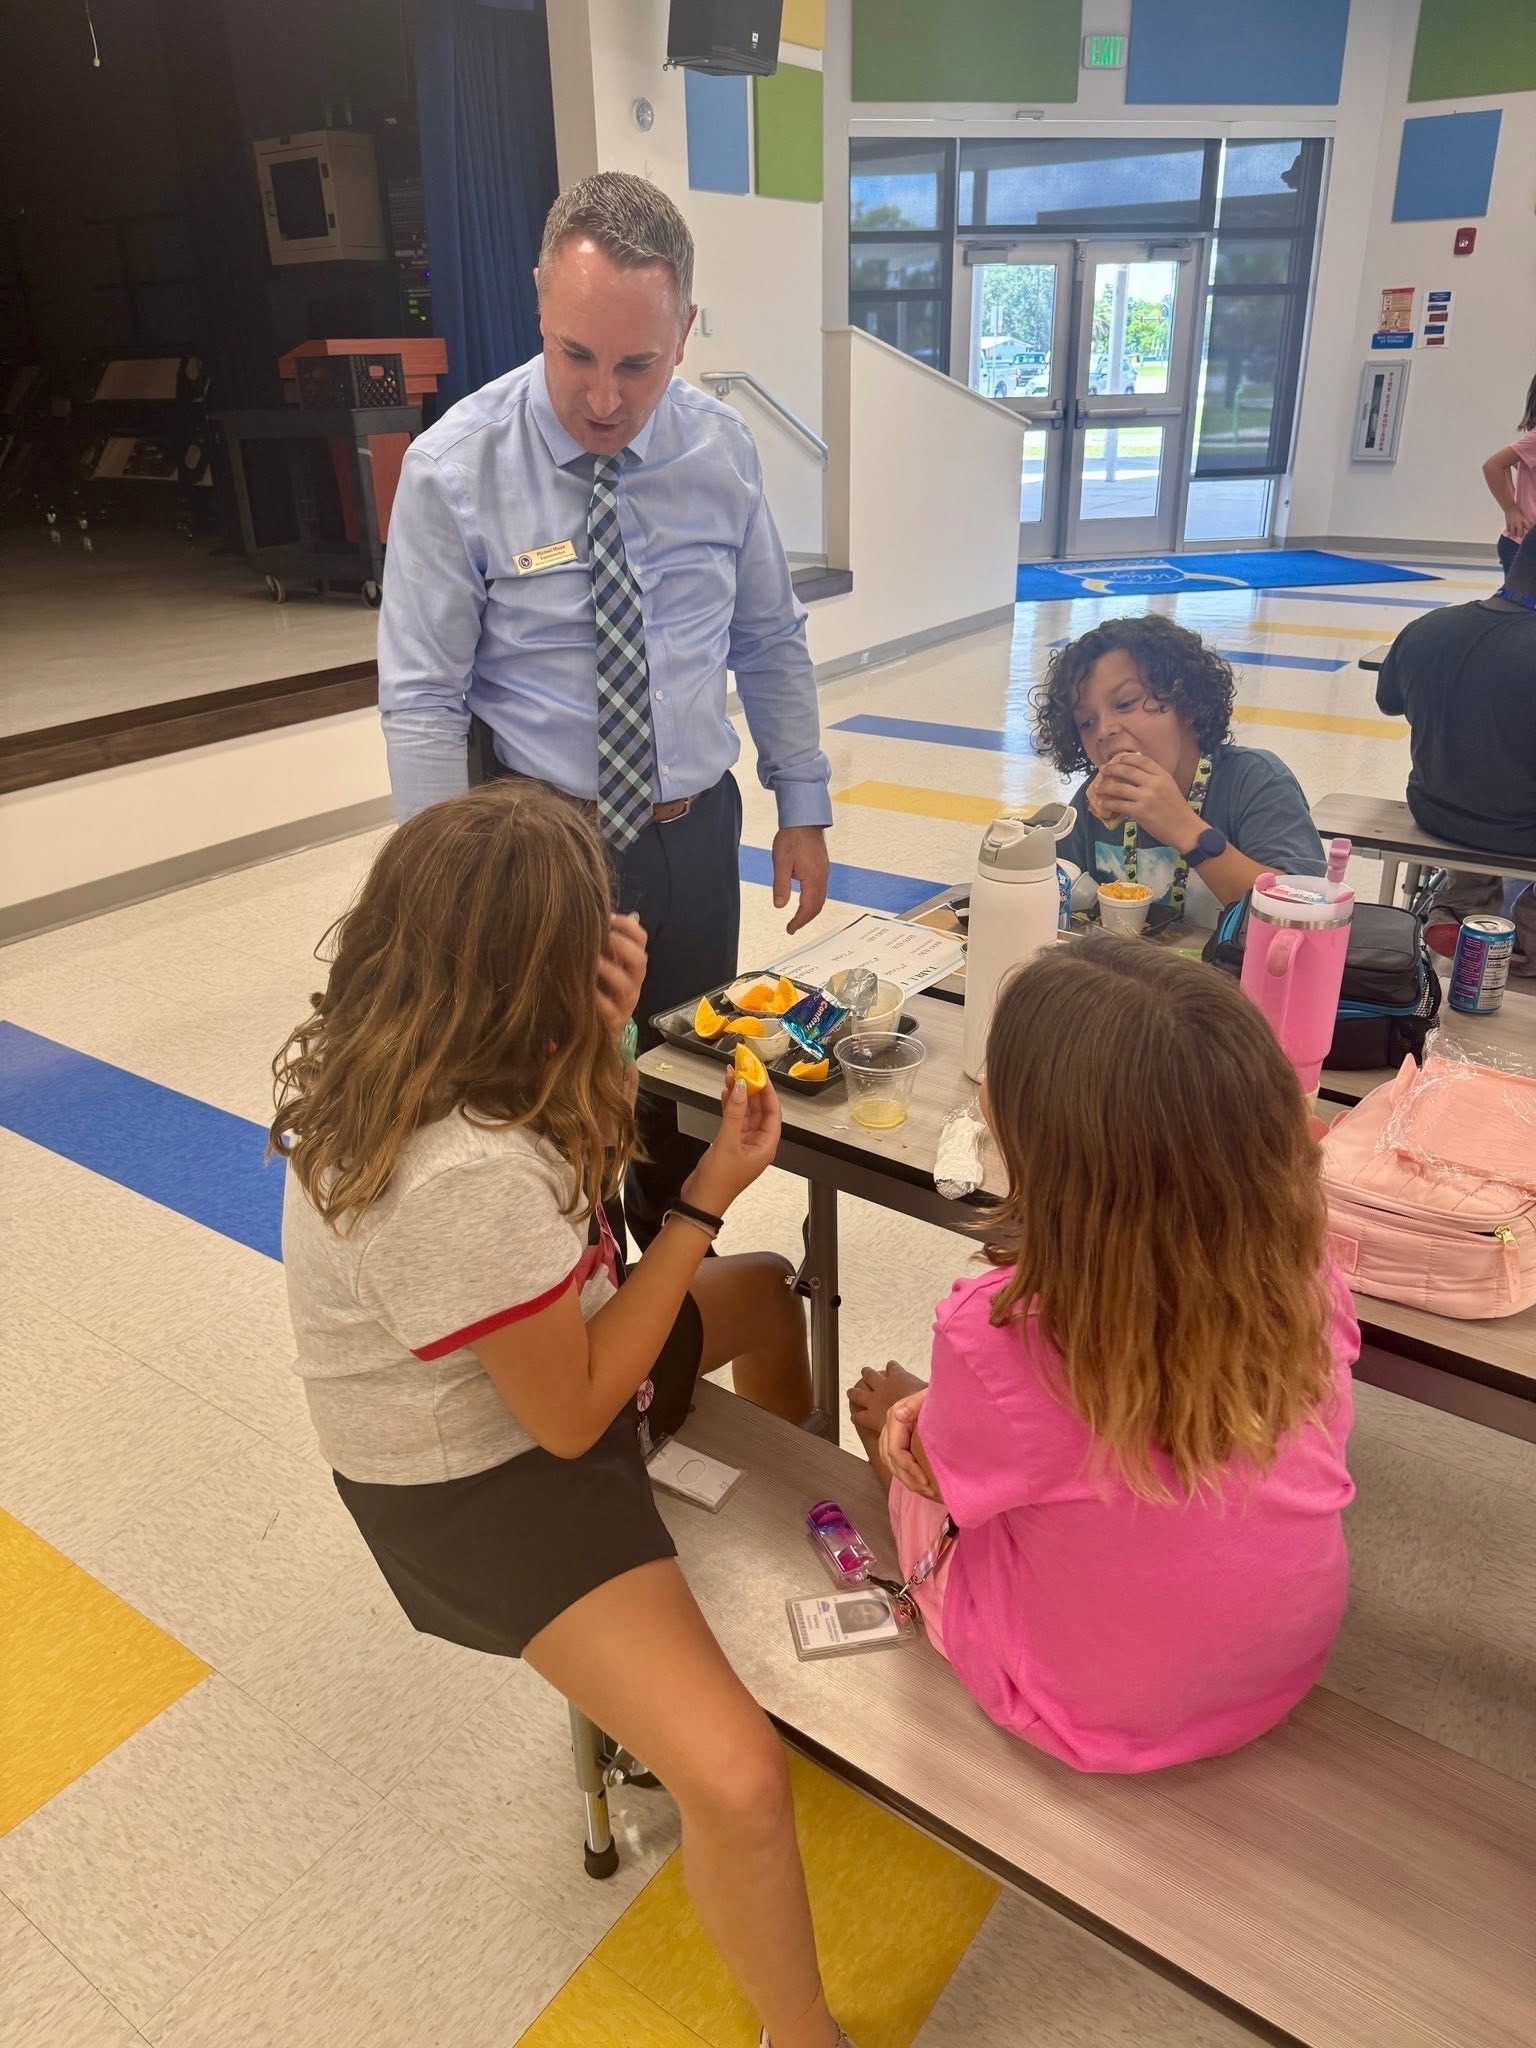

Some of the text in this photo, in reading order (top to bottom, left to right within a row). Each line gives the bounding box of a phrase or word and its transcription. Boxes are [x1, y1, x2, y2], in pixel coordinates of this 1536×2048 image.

[1091, 36, 1122, 65] EXIT
[910, 965, 939, 982] TABLE
[804, 1001, 828, 1032] Confetti
